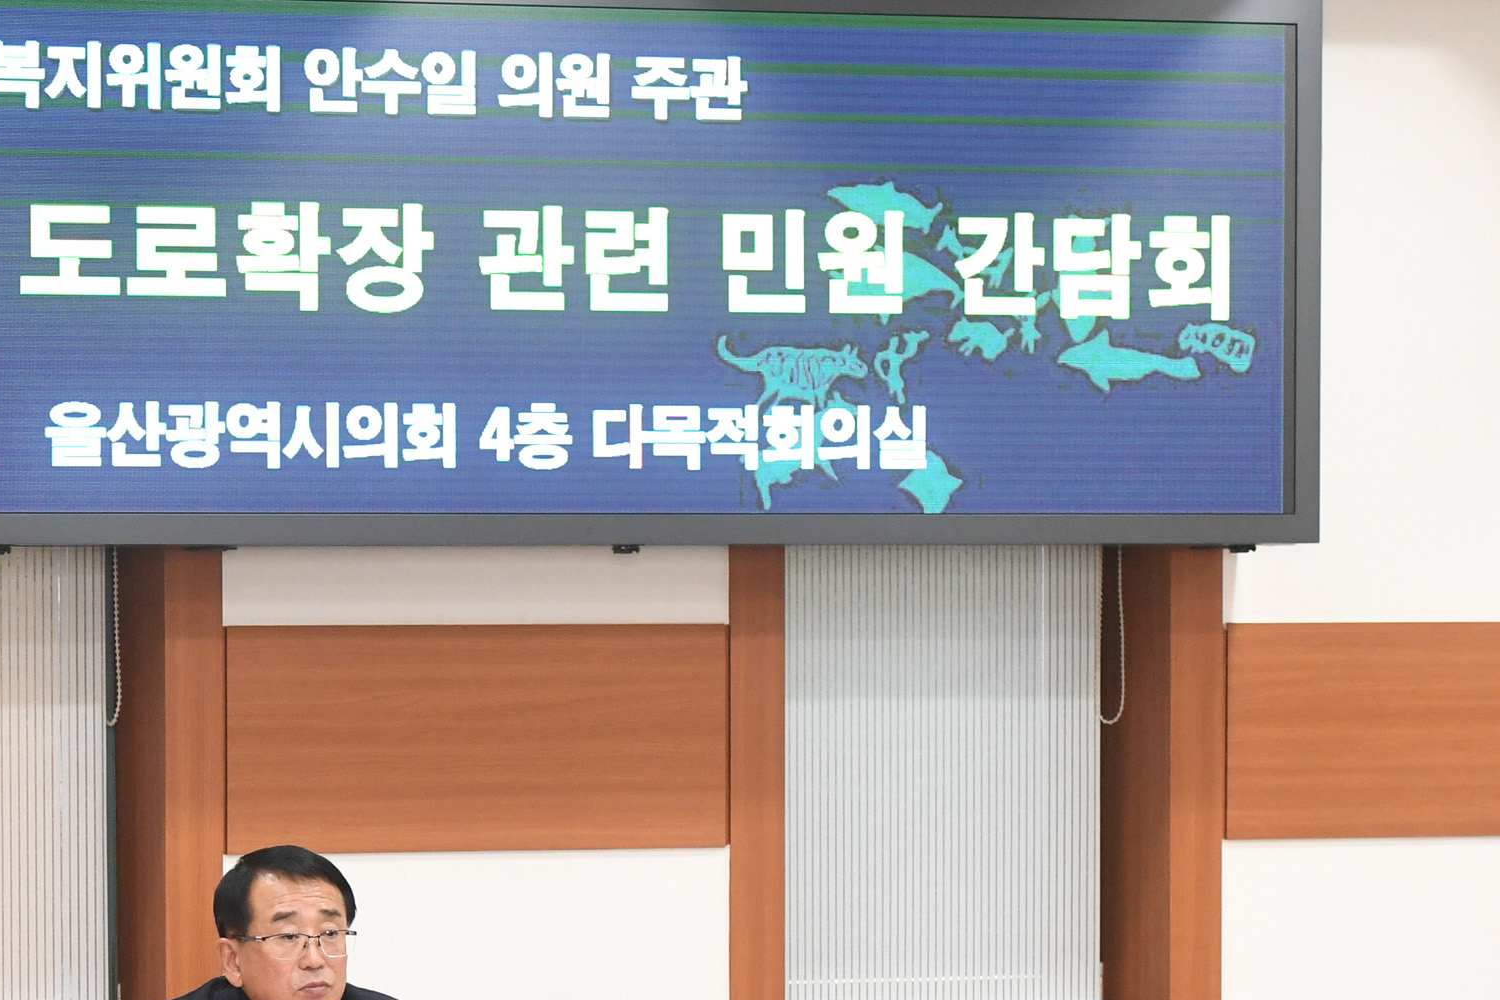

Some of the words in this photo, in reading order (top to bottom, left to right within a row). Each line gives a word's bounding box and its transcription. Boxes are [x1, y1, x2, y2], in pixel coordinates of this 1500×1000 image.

[304, 47, 477, 115] 안수일
[497, 52, 611, 118] 의원
[631, 56, 748, 121] 주관
[20, 202, 434, 313] 도로확장
[479, 205, 669, 312] 관련
[722, 209, 905, 314] 민원
[955, 212, 1230, 321] 간담회
[45, 401, 456, 469] 울산광역시의회
[479, 402, 573, 470] 4층
[593, 404, 928, 471] 다목적회의실
